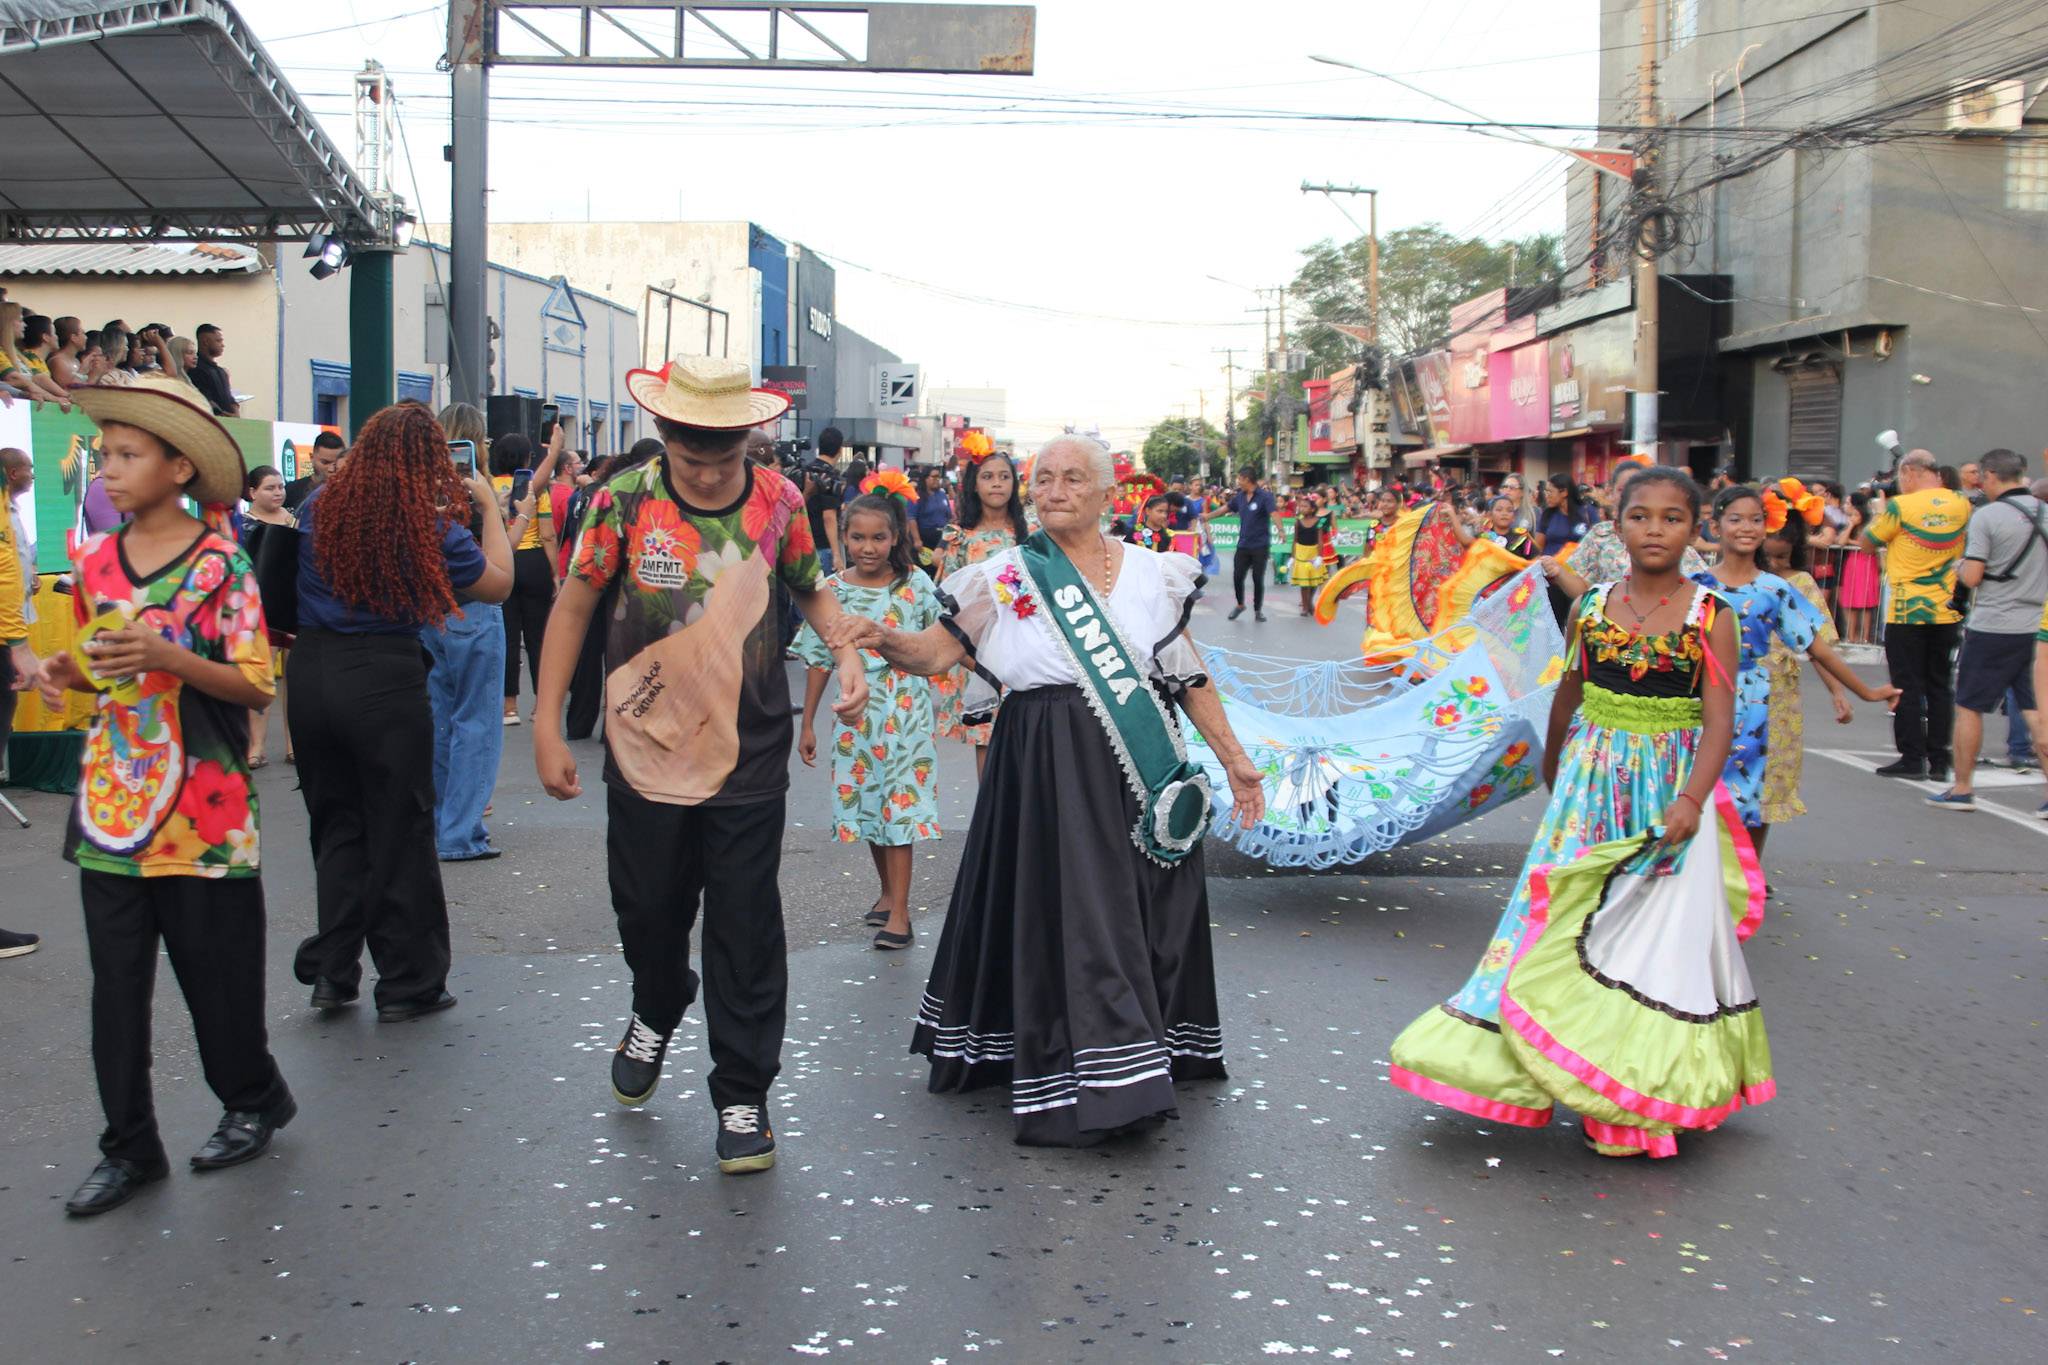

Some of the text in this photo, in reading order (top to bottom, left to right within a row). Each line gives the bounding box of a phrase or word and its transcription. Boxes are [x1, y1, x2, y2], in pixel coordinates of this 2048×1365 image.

[880, 371, 888, 406] STUDIO
[642, 559, 682, 574] AMFMT
[1054, 584, 1138, 706] SINHA
